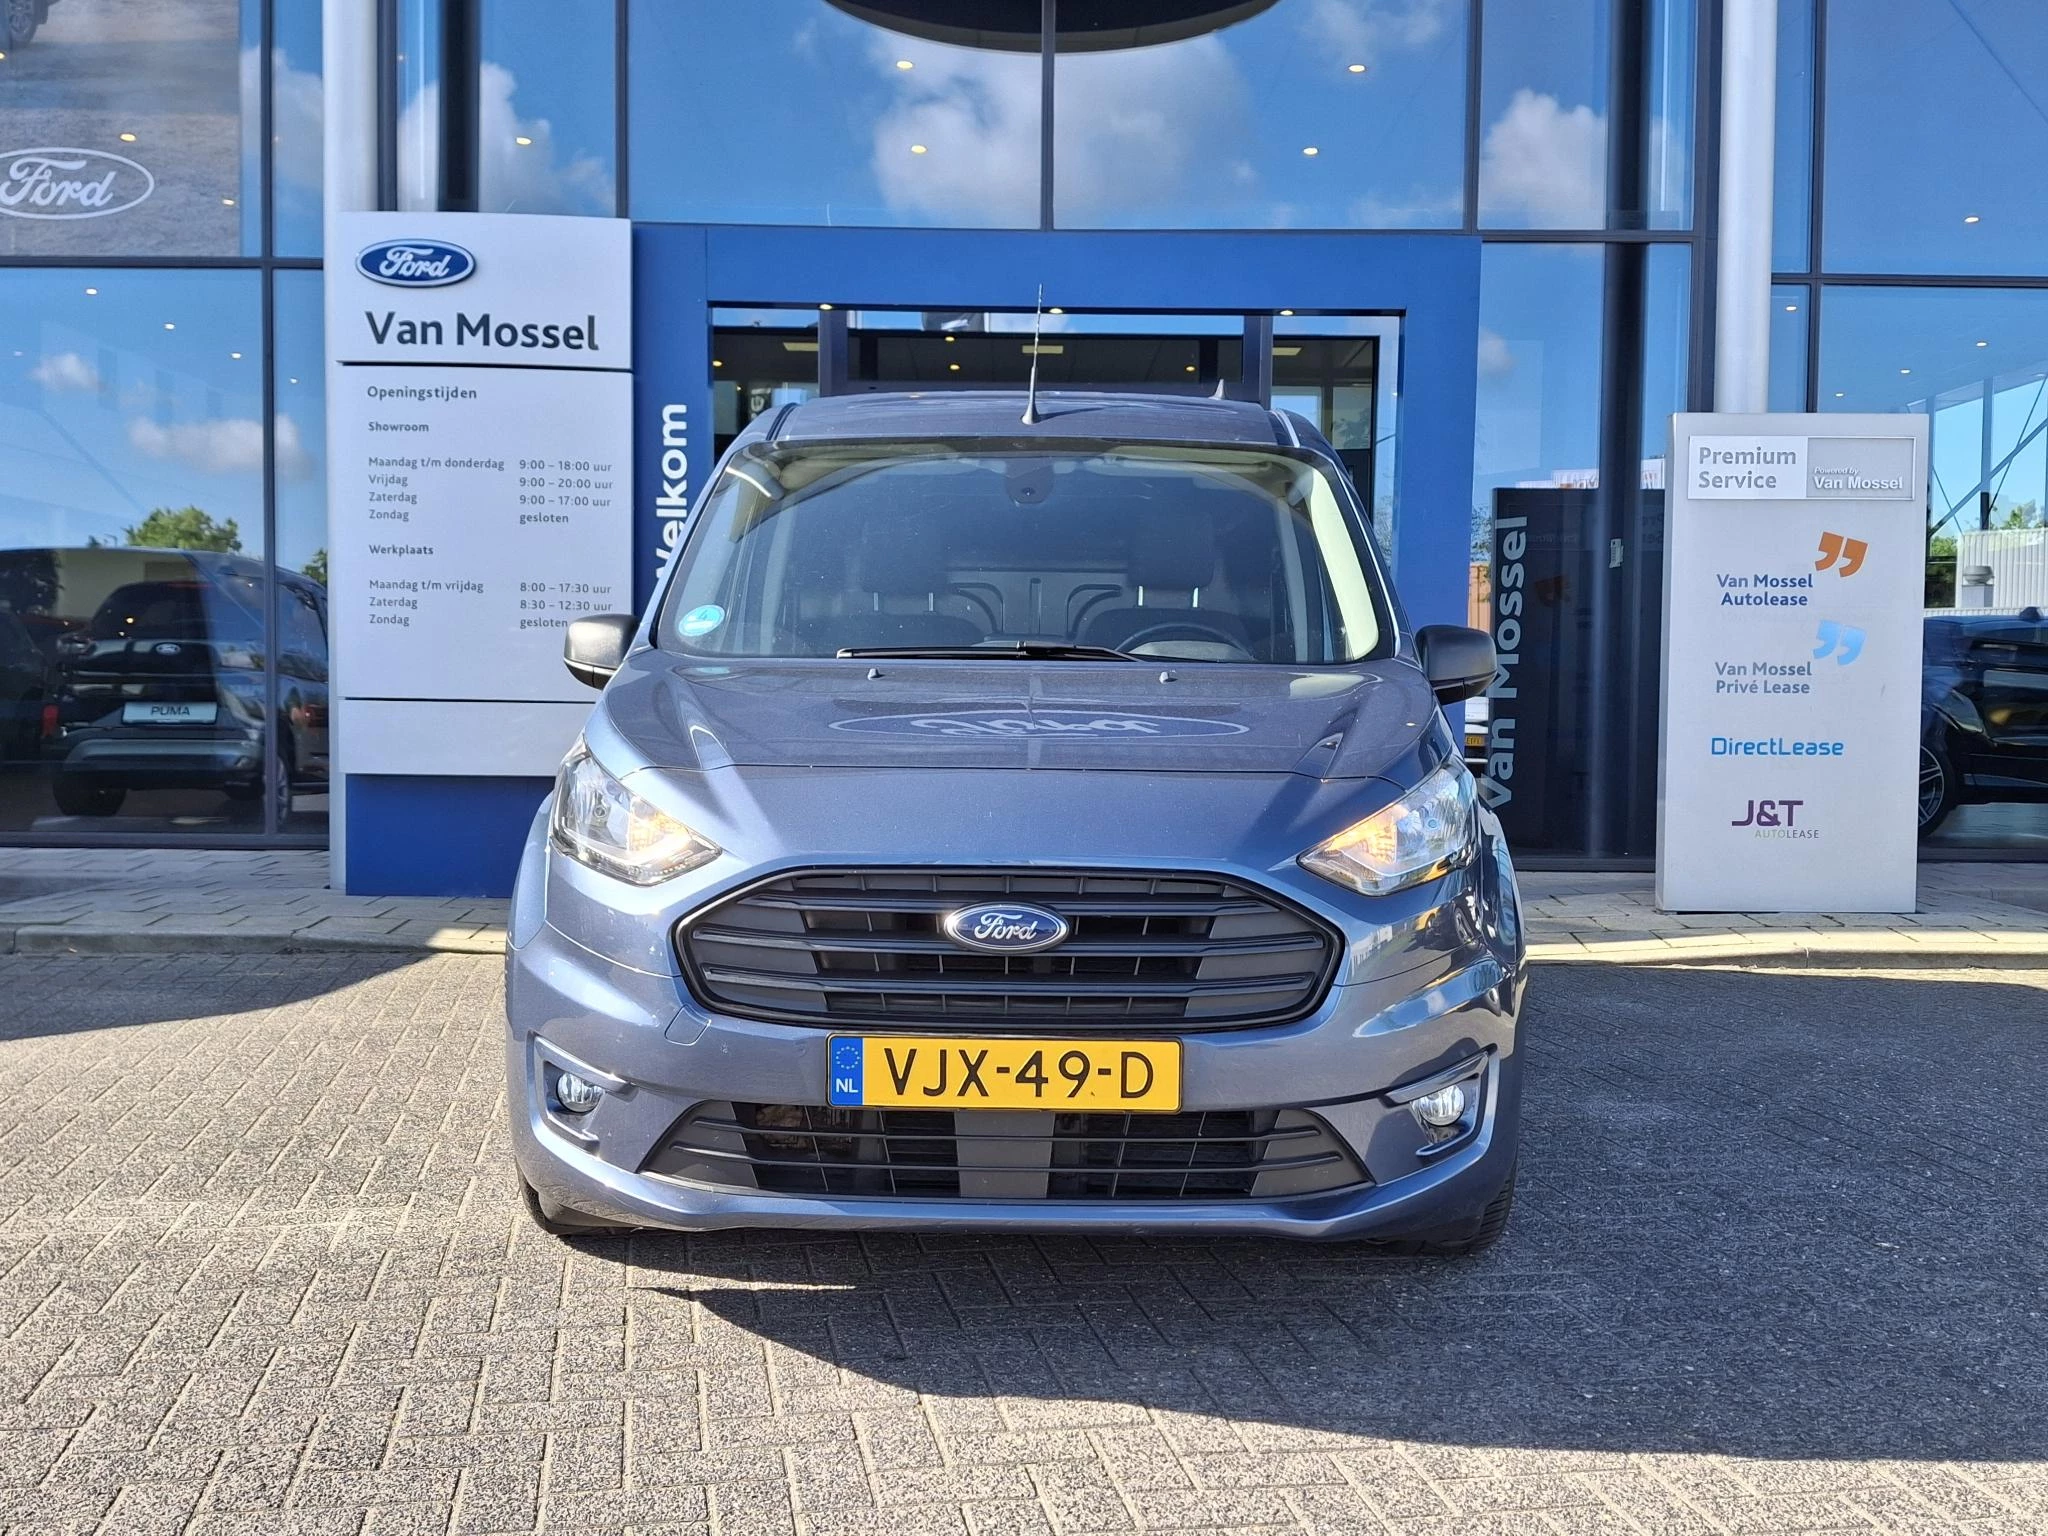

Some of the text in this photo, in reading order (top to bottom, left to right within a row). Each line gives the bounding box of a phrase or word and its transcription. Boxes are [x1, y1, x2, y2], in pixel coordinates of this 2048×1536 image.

[0, 157, 116, 206] Ford
[379, 246, 451, 277] Ford
[365, 311, 599, 351] Van Mossel
[367, 386, 477, 402] Openingstijden
[368, 421, 429, 432] Showroom
[1699, 447, 1796, 465] Premium
[369, 457, 504, 471] Maandag t/m donderdag
[519, 460, 545, 470] 9:00
[558, 461, 590, 471] 18:00
[594, 463, 612, 472] uur
[1814, 466, 1859, 475] Powered by
[369, 475, 408, 487] Vrijdag
[519, 477, 545, 487] 9:00
[558, 478, 591, 489] 20:00
[595, 481, 613, 489] uur
[1698, 471, 1777, 489] Service
[1814, 477, 1903, 490] Van Mossel
[369, 492, 417, 504] Zaterdag
[656, 404, 687, 578] elkom
[519, 495, 545, 505] 9:00
[559, 496, 589, 506] 17:00
[593, 498, 611, 506] uur
[369, 509, 409, 522] Zondag
[520, 513, 569, 525] gesloten
[369, 545, 434, 558] Werkplaats
[369, 580, 484, 594] Maandag t/m vrijdag
[520, 582, 546, 593] 8:00
[559, 583, 589, 594] 17:30
[593, 586, 611, 594] uur
[1716, 574, 1813, 588] Van Mossel
[369, 597, 418, 609] Zaterdag
[520, 599, 546, 610] 8:30
[559, 601, 590, 611] 12:30
[594, 603, 612, 611] uur
[1721, 592, 1808, 606] Autolease
[369, 614, 409, 626] Zondag
[520, 618, 568, 629] gesloten
[1477, 516, 1528, 809] Van Mossel
[1715, 661, 1812, 676] Van Mossel
[1716, 679, 1810, 693] Privé Lease
[151, 706, 190, 716] PUMA
[1711, 738, 1844, 755] DirectLease
[1731, 800, 1804, 827] J&T
[1755, 830, 1819, 839] AUTOLEASE
[974, 912, 1037, 941] Ford
[884, 1048, 1154, 1099] VJX-49-D
[835, 1078, 858, 1094] NL
